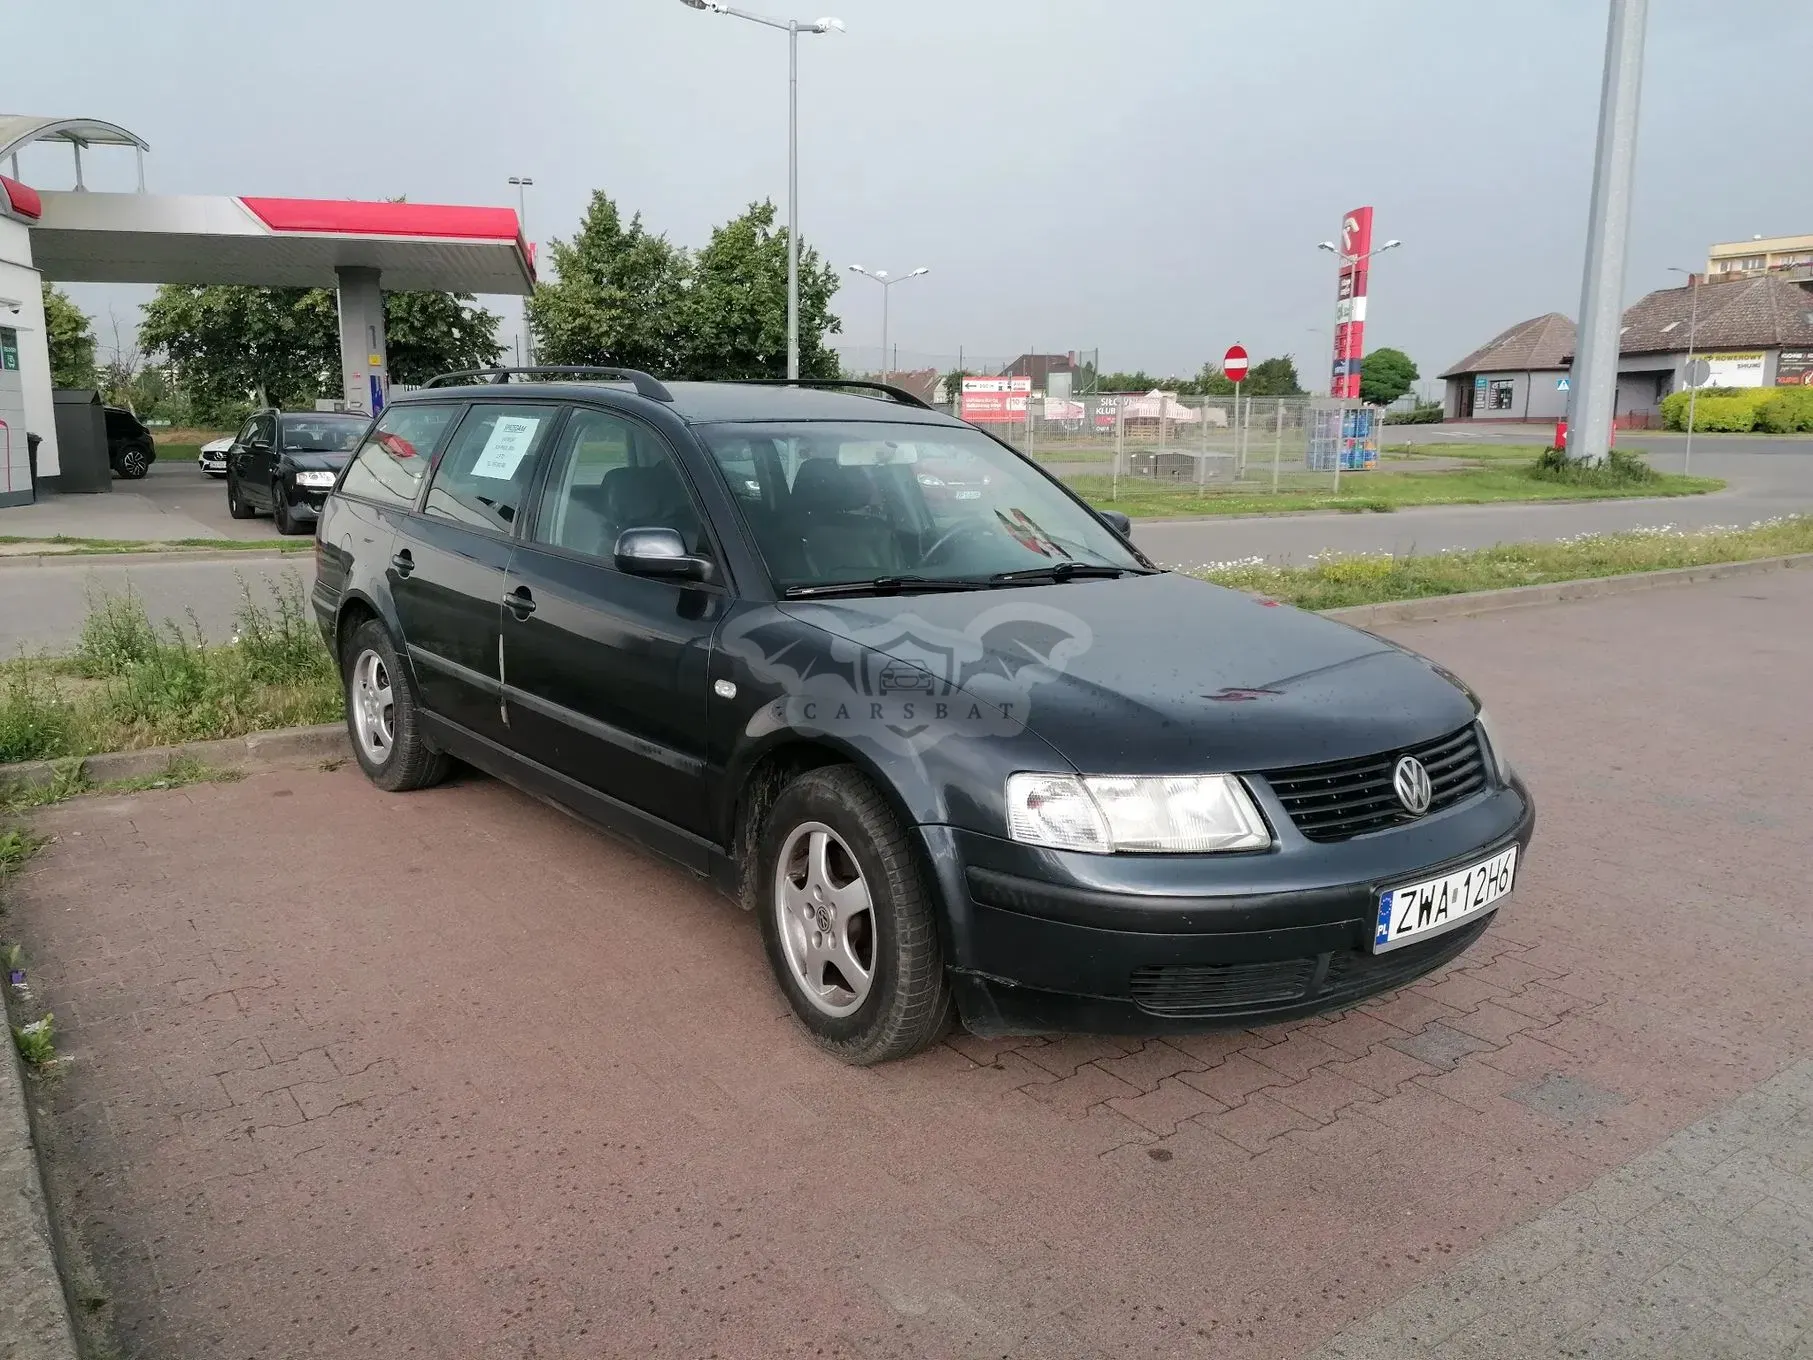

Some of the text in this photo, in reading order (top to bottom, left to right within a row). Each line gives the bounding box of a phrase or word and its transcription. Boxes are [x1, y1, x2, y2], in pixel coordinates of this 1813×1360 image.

[1095, 407, 1116, 415] KLUB
[1396, 853, 1512, 934] ZWA 12H6
[1377, 924, 1388, 937] PL
